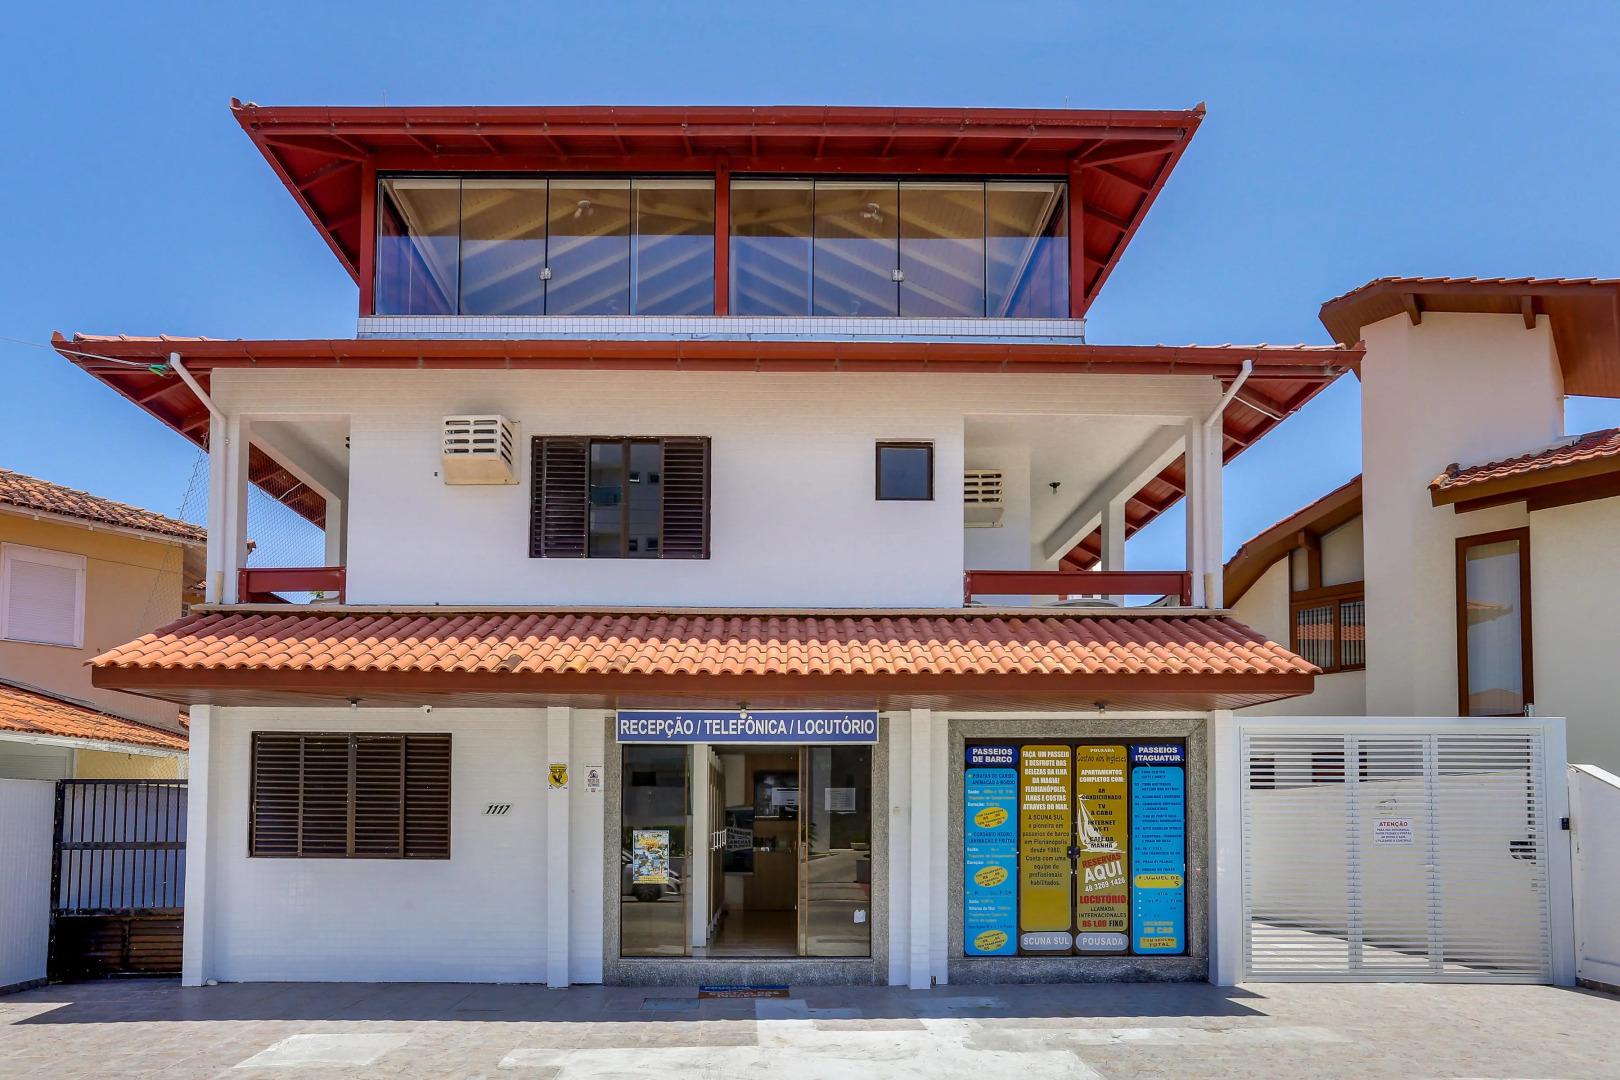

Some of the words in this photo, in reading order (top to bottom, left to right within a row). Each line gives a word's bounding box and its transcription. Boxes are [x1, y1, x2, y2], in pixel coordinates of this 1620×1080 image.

[620, 716, 694, 738] RECEPÇÃO
[696, 719, 701, 736] /
[704, 716, 787, 735] TELEFÔNICA
[790, 719, 794, 736] /
[798, 715, 874, 735] LOCUTÓRIO
[1026, 785, 1066, 793] FLORIANÓPOLIS,
[486, 804, 510, 814] 1117
[1082, 853, 1121, 868] RESERVAS
[1085, 860, 1122, 884] AQUI
[1094, 881, 1109, 890] 3269
[1110, 877, 1126, 886] 1426
[1080, 893, 1126, 904] LOCUTÓRIO
[1023, 937, 1051, 945] SCUNA
[1054, 937, 1069, 945] SUL
[1082, 937, 1123, 945] POUSADA
